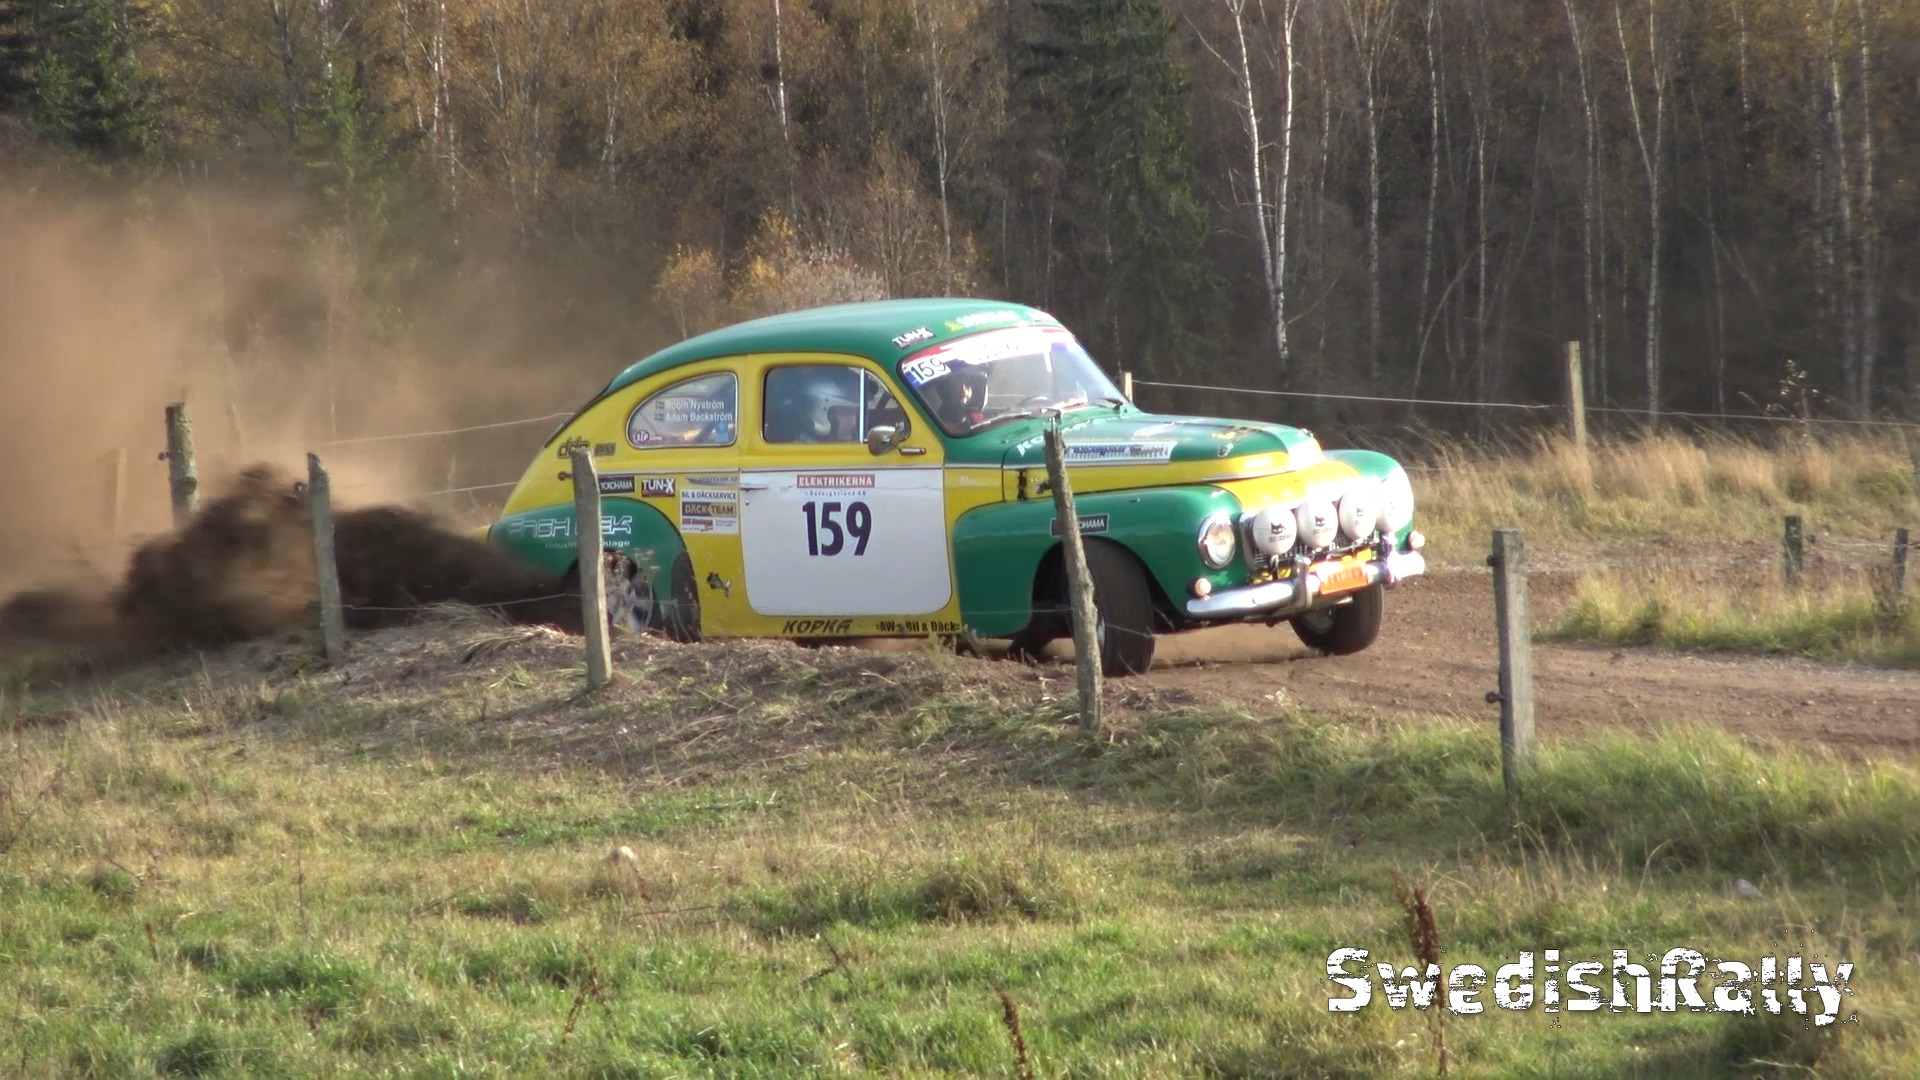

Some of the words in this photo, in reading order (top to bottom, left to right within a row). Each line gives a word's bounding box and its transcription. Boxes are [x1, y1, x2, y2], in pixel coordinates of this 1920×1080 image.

[891, 327, 934, 346] TUN-X
[910, 358, 947, 381] 159
[665, 412, 688, 422] Adam
[636, 431, 649, 442] STP
[600, 480, 634, 490] YOKOHAMA
[642, 478, 675, 494] TUN-X
[799, 476, 873, 487] ELEKTRIKERNA
[710, 505, 735, 515] TEAM
[802, 500, 872, 556] 159
[782, 619, 854, 634] KOPKA
[905, 620, 920, 632] Bil
[922, 622, 928, 632] &
